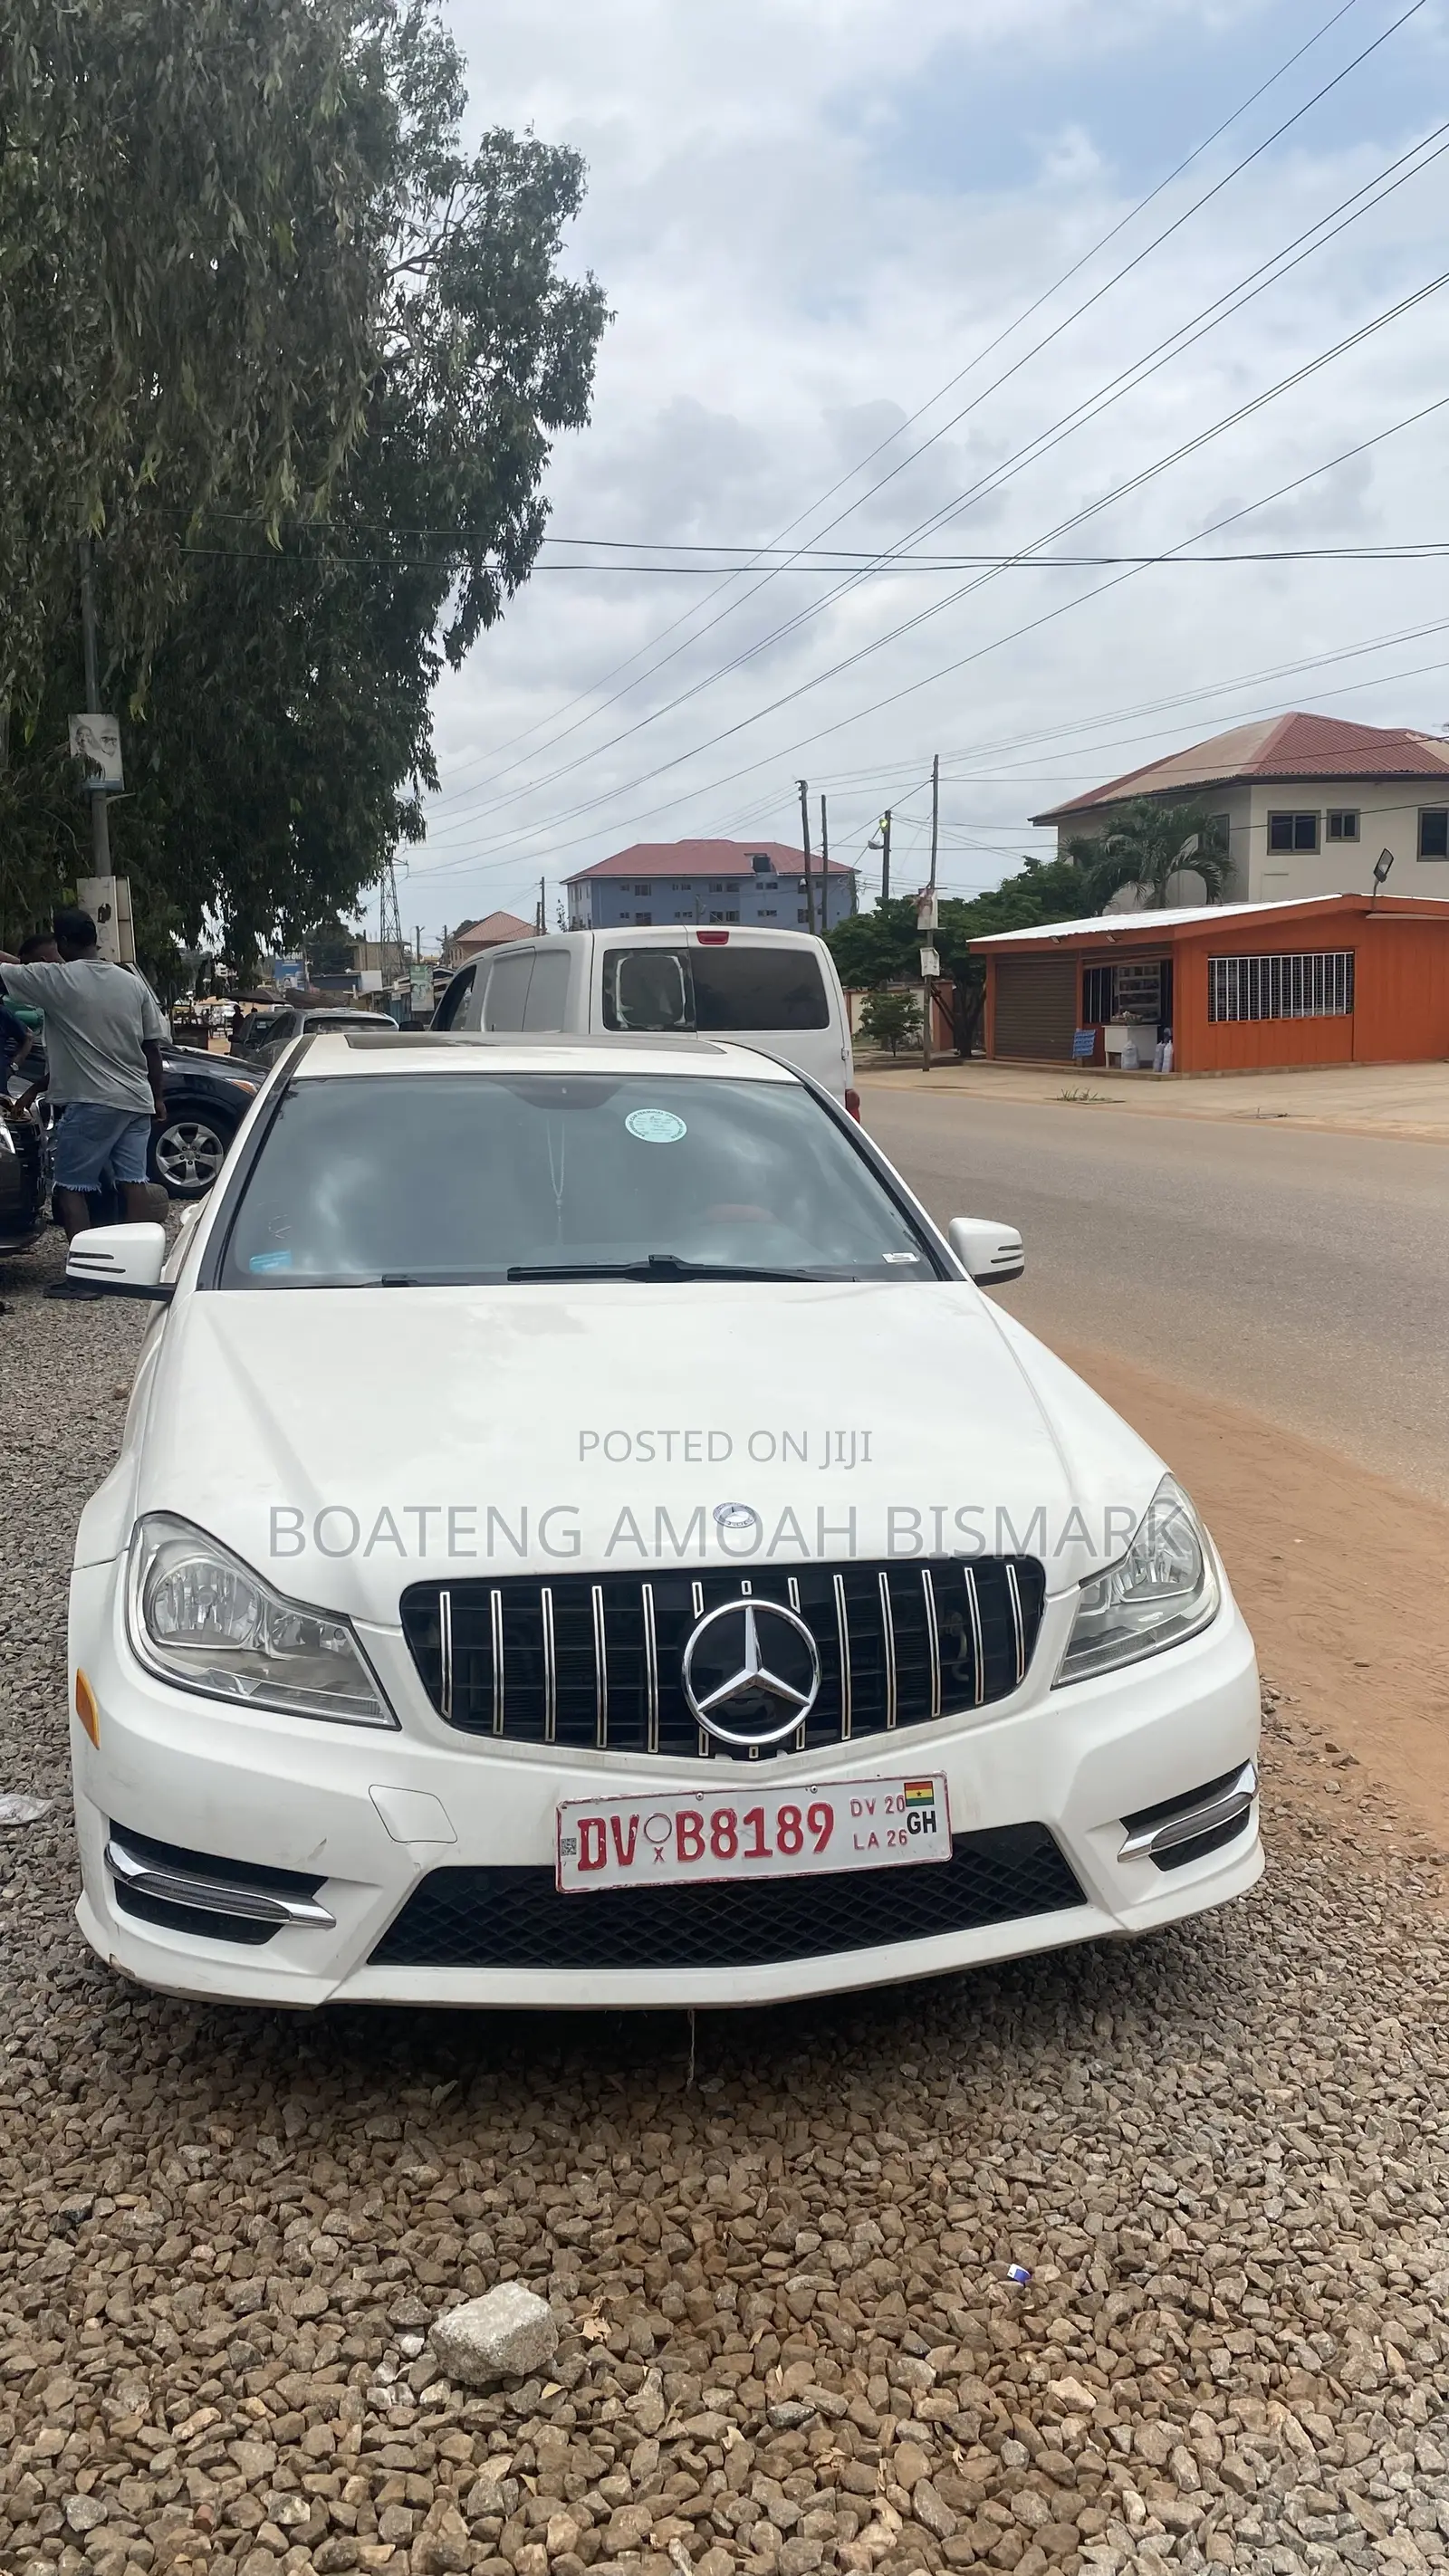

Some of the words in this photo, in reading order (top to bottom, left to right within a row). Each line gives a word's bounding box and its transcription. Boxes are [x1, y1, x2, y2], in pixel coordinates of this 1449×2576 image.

[849, 1796, 876, 1817] DV
[885, 1794, 906, 1815] 20
[907, 1810, 936, 1834] GH
[578, 1814, 640, 1871] DV
[676, 1801, 834, 1863] B8189
[853, 1831, 879, 1851] LA
[887, 1828, 907, 1848] 26
